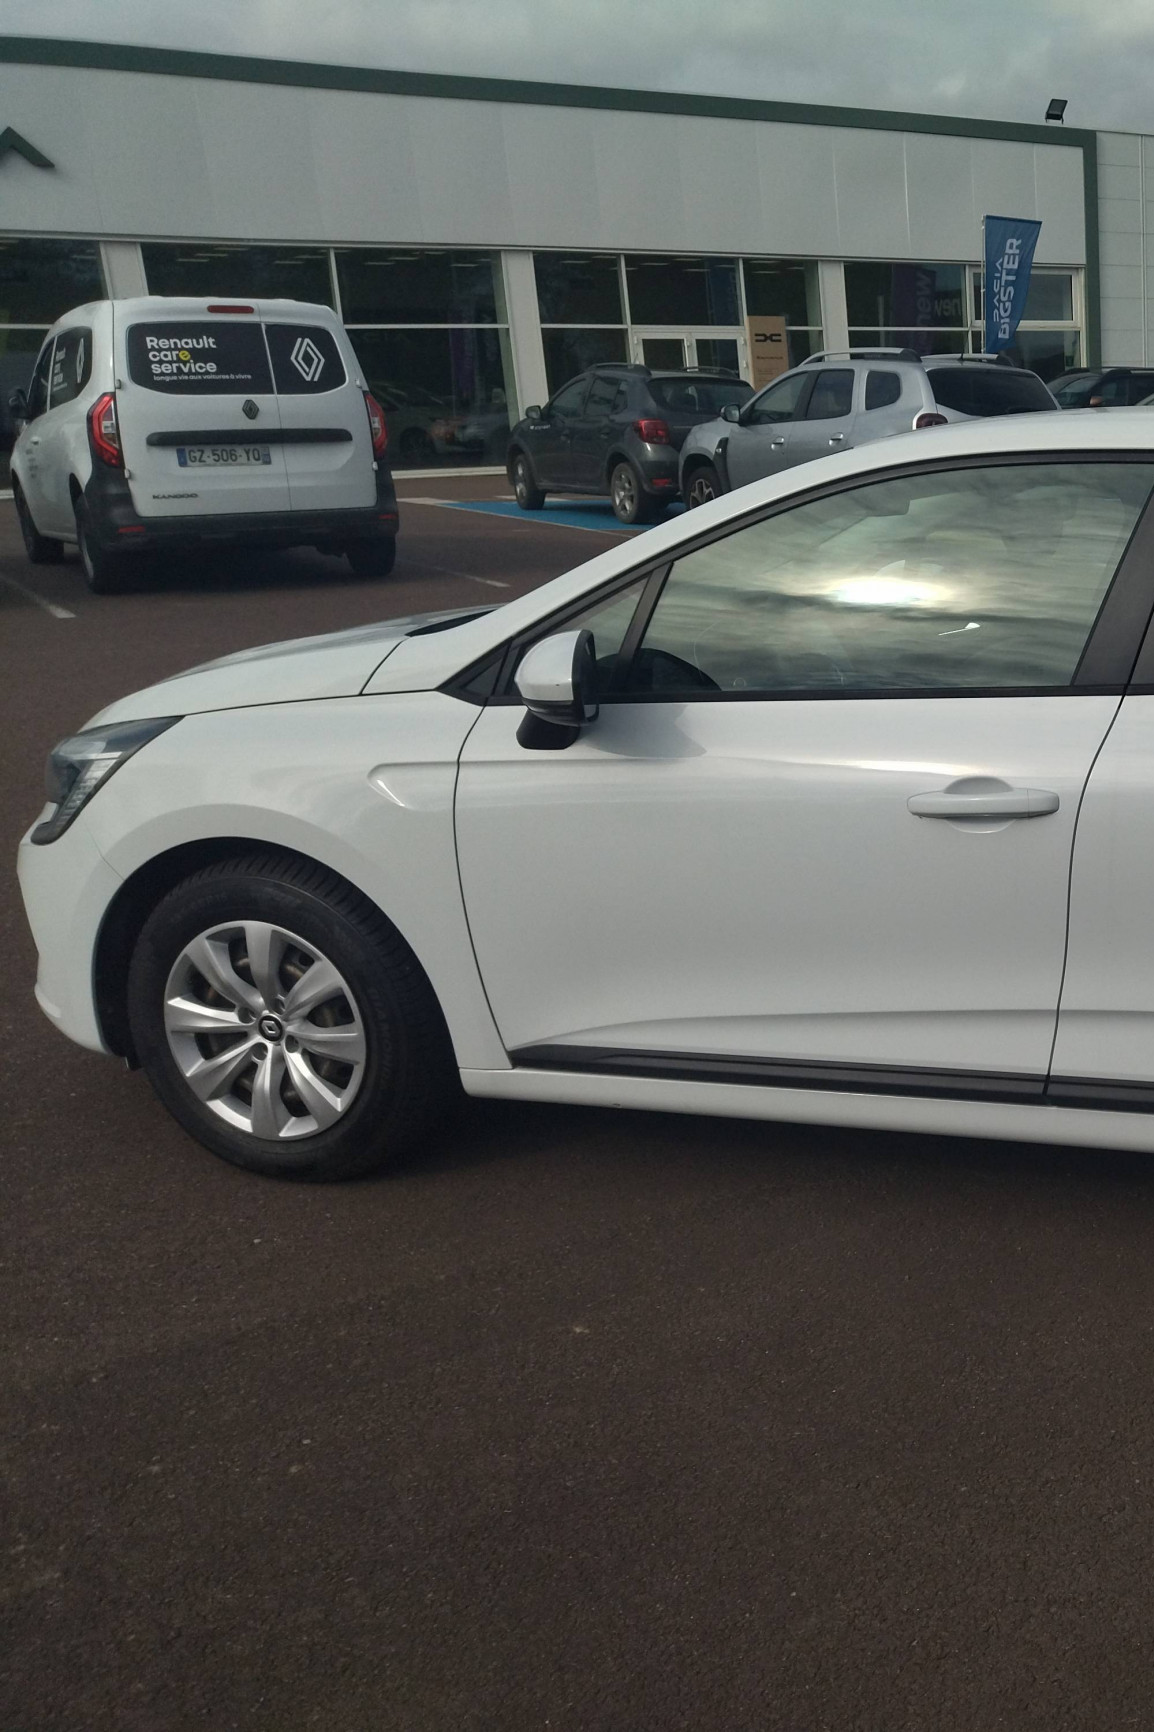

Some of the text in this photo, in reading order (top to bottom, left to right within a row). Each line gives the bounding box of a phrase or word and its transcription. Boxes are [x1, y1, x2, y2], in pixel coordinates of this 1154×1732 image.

[997, 238, 1022, 339] BIGSTER
[145, 335, 217, 349] Renault
[148, 350, 191, 362] care
[151, 360, 217, 374] service
